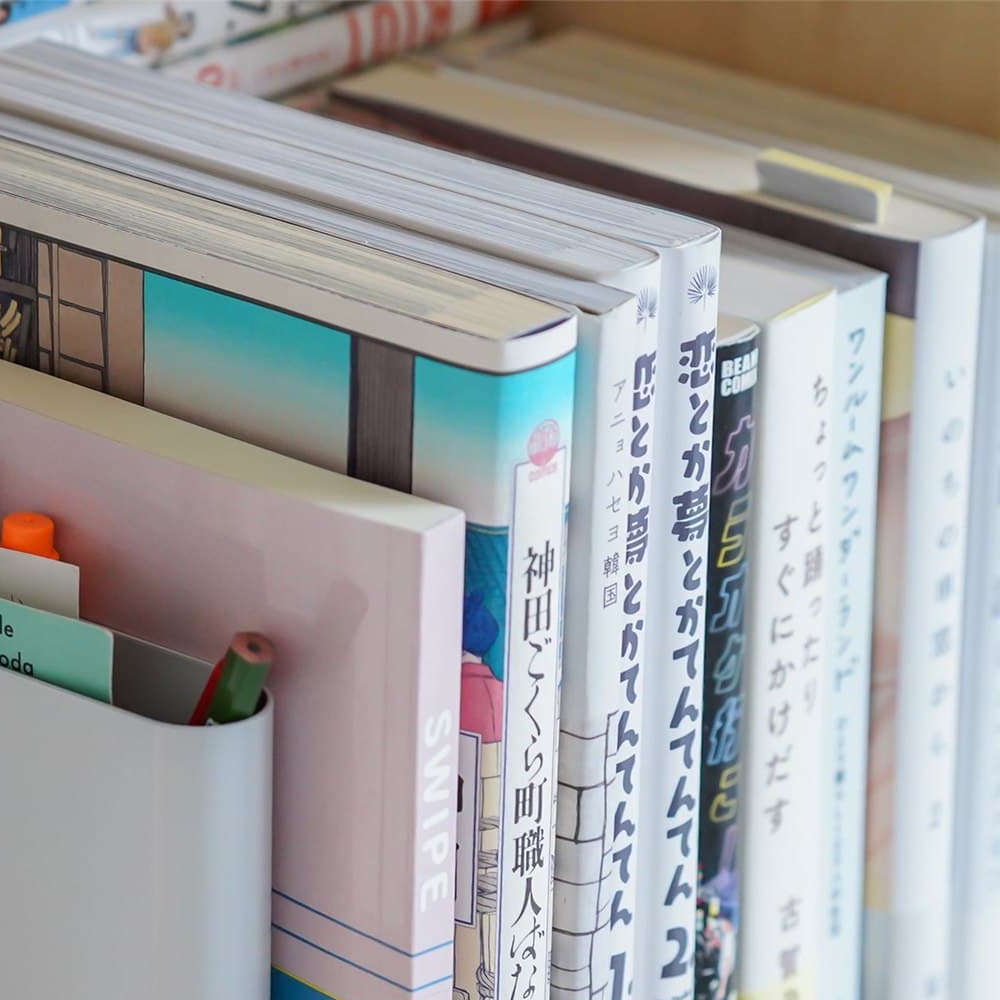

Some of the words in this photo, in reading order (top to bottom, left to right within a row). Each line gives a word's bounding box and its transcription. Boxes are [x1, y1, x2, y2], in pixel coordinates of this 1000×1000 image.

[602, 378, 627, 608] アニョハセヨ韓国
[664, 327, 717, 907] 恋とか夢とかてんてんてん
[418, 708, 451, 913] SWIPE
[660, 927, 689, 979] 2
